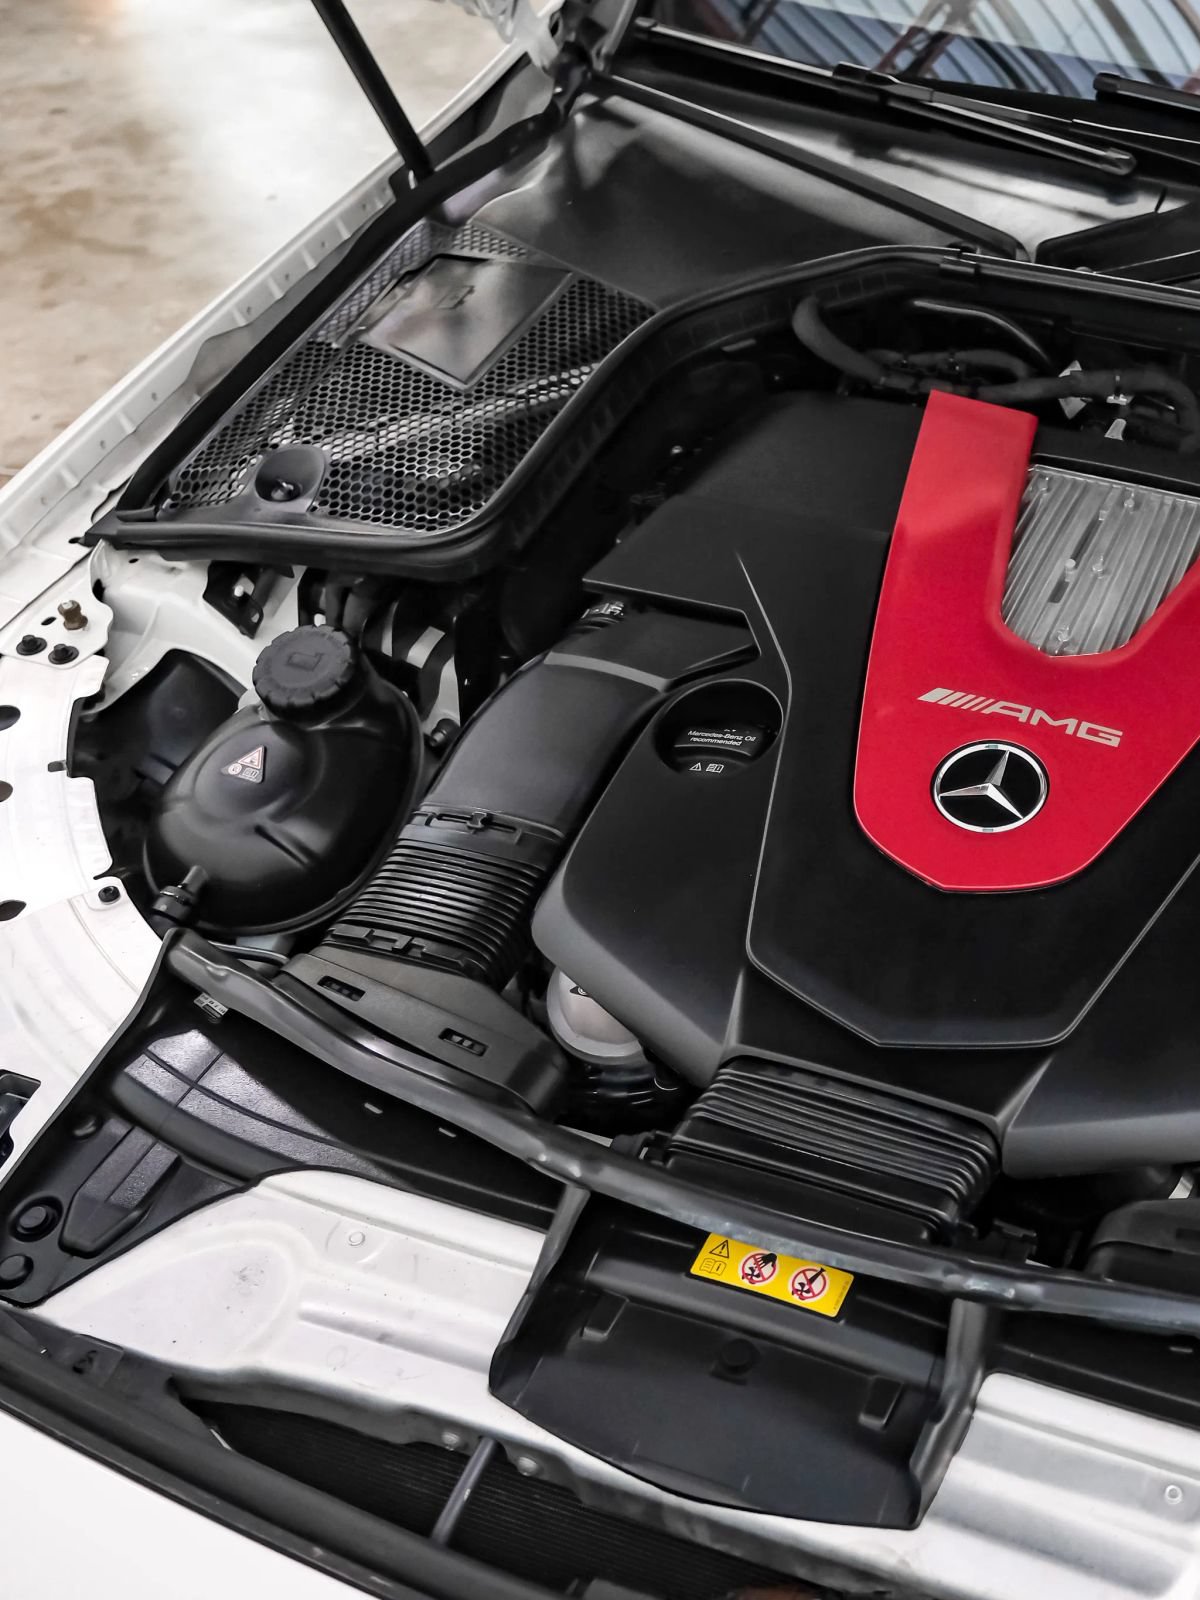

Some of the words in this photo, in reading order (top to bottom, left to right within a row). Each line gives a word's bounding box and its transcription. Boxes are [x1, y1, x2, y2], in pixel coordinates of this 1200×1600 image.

[985, 700, 1123, 748] AMG
[687, 730, 744, 740] Mercedes-Benz
[689, 737, 743, 746] recommended
